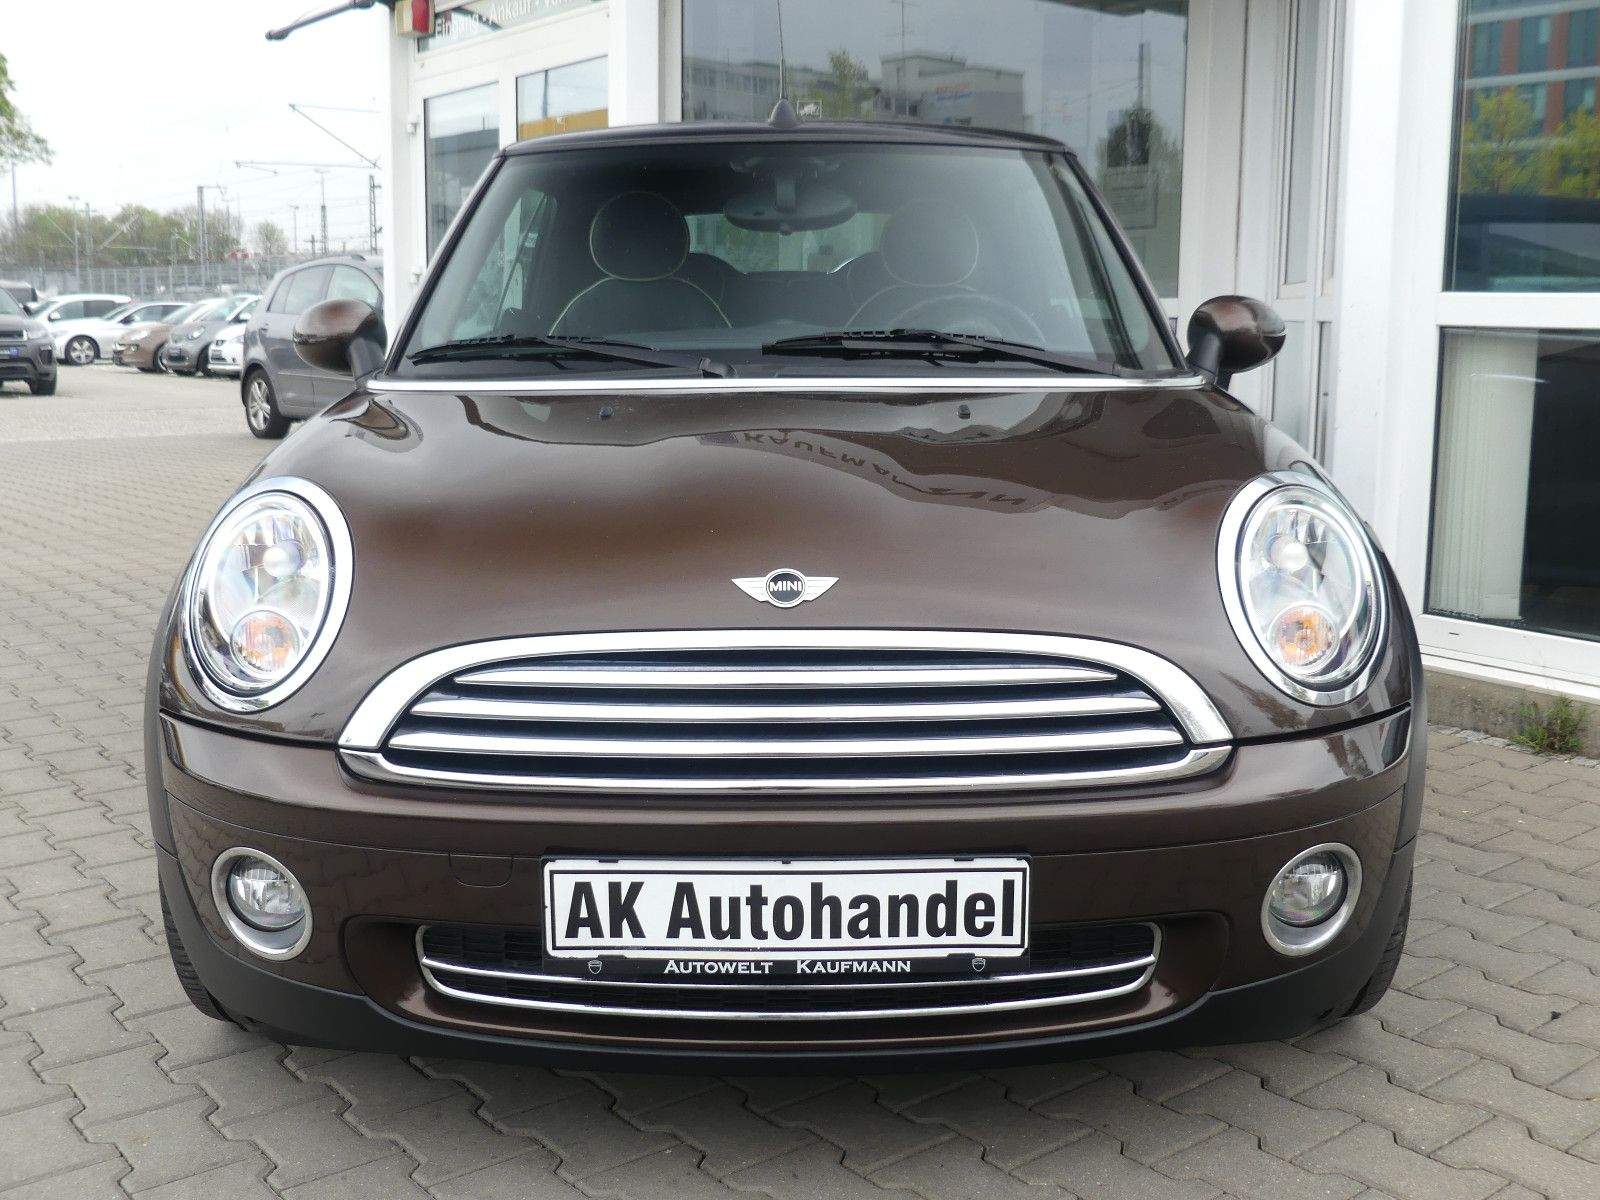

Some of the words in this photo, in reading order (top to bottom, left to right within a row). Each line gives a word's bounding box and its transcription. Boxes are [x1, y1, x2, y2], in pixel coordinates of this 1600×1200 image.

[769, 580, 803, 592] MINI
[564, 880, 646, 939] AK
[665, 879, 1016, 941] Autohandel
[663, 958, 774, 975] AUTOWELT
[796, 957, 912, 975] KAUFMANN
